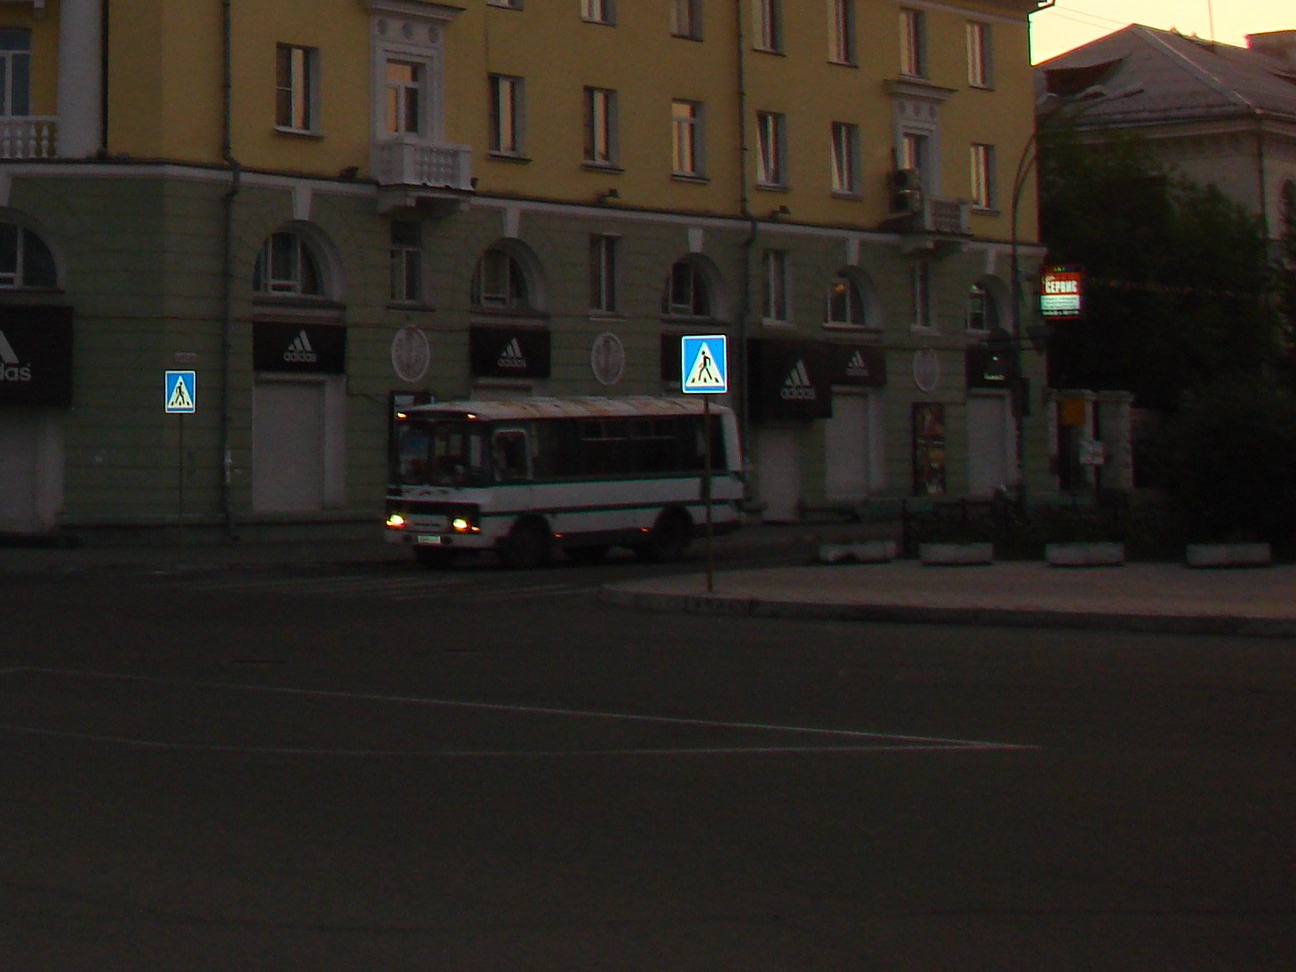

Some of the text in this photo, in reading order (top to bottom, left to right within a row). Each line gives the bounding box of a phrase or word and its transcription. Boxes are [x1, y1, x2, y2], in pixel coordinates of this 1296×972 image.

[283, 350, 317, 363] adidas
[497, 357, 527, 369] adidas
[780, 385, 816, 400] adidas
